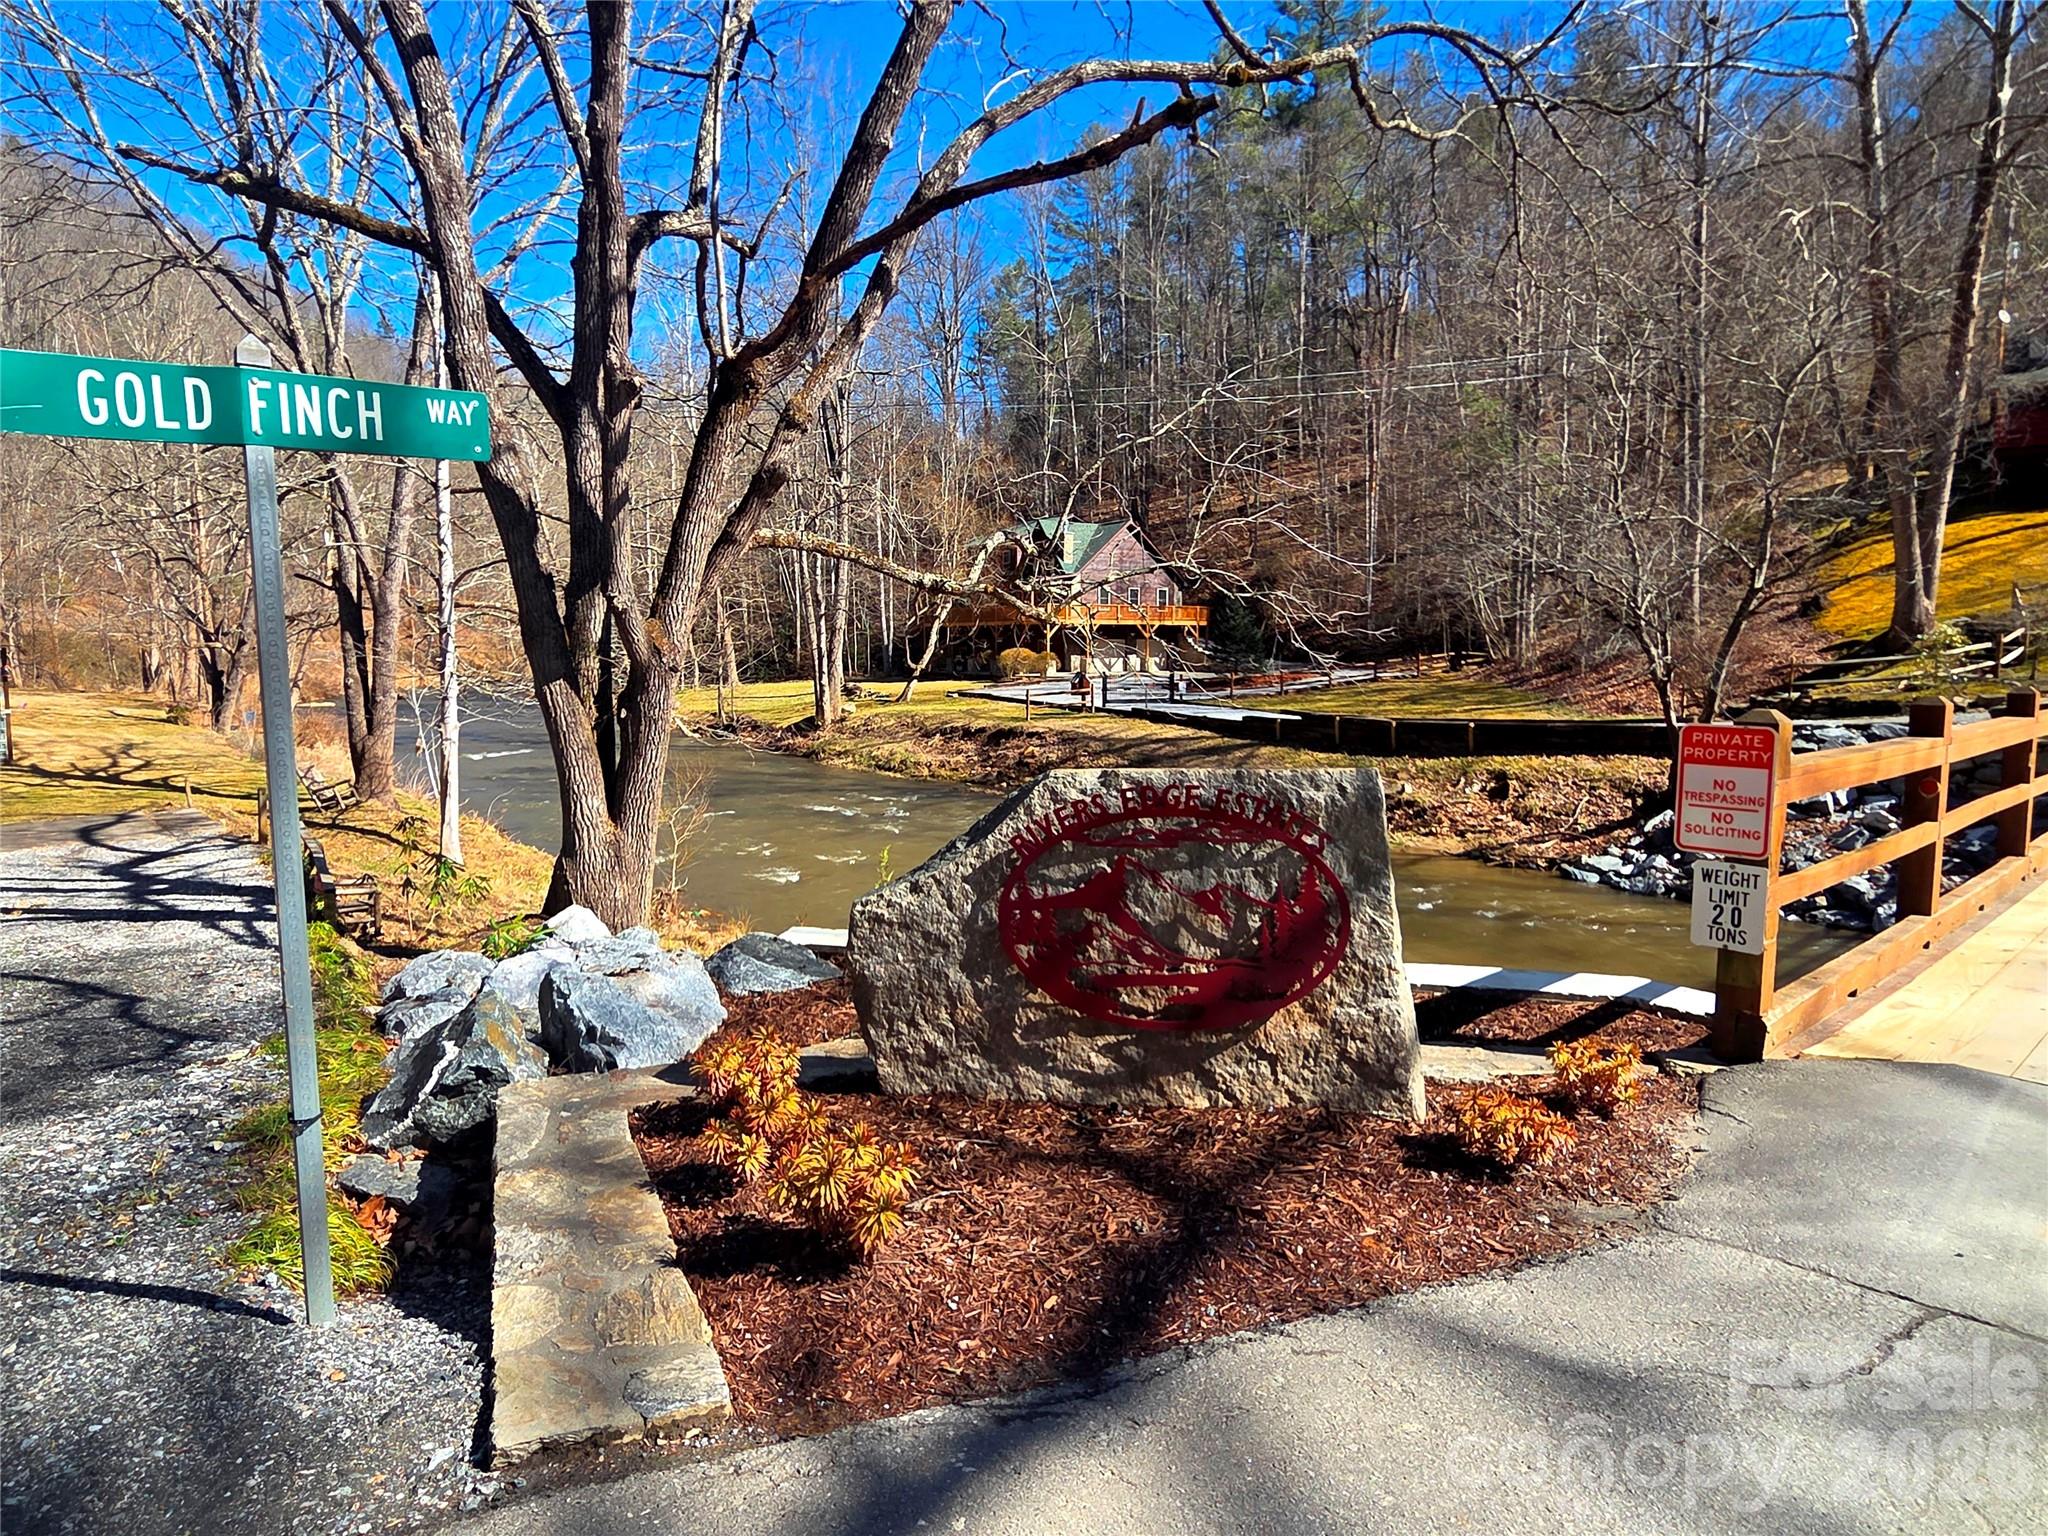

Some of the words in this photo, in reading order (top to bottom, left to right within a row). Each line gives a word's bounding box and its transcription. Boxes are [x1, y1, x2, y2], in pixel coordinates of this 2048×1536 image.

[77, 368, 213, 432] GOLD
[248, 380, 384, 441] FINCH
[426, 398, 479, 427] WAY
[1692, 732, 1765, 748] PRIVATE
[1683, 747, 1772, 764] PROPERTY
[1712, 779, 1736, 792] NO
[1684, 790, 1766, 808] TRESPASSING
[1008, 793, 1110, 857] RIVERS
[1120, 784, 1203, 813] EDGE
[1214, 787, 1332, 855] ESTATES
[1711, 812, 1734, 825] NO
[1684, 823, 1762, 841] SOLICITING
[1701, 867, 1761, 890] WEIGHT
[1708, 887, 1750, 908] LIMIT
[1711, 904, 1742, 928] 20
[1707, 924, 1748, 946] TONS
